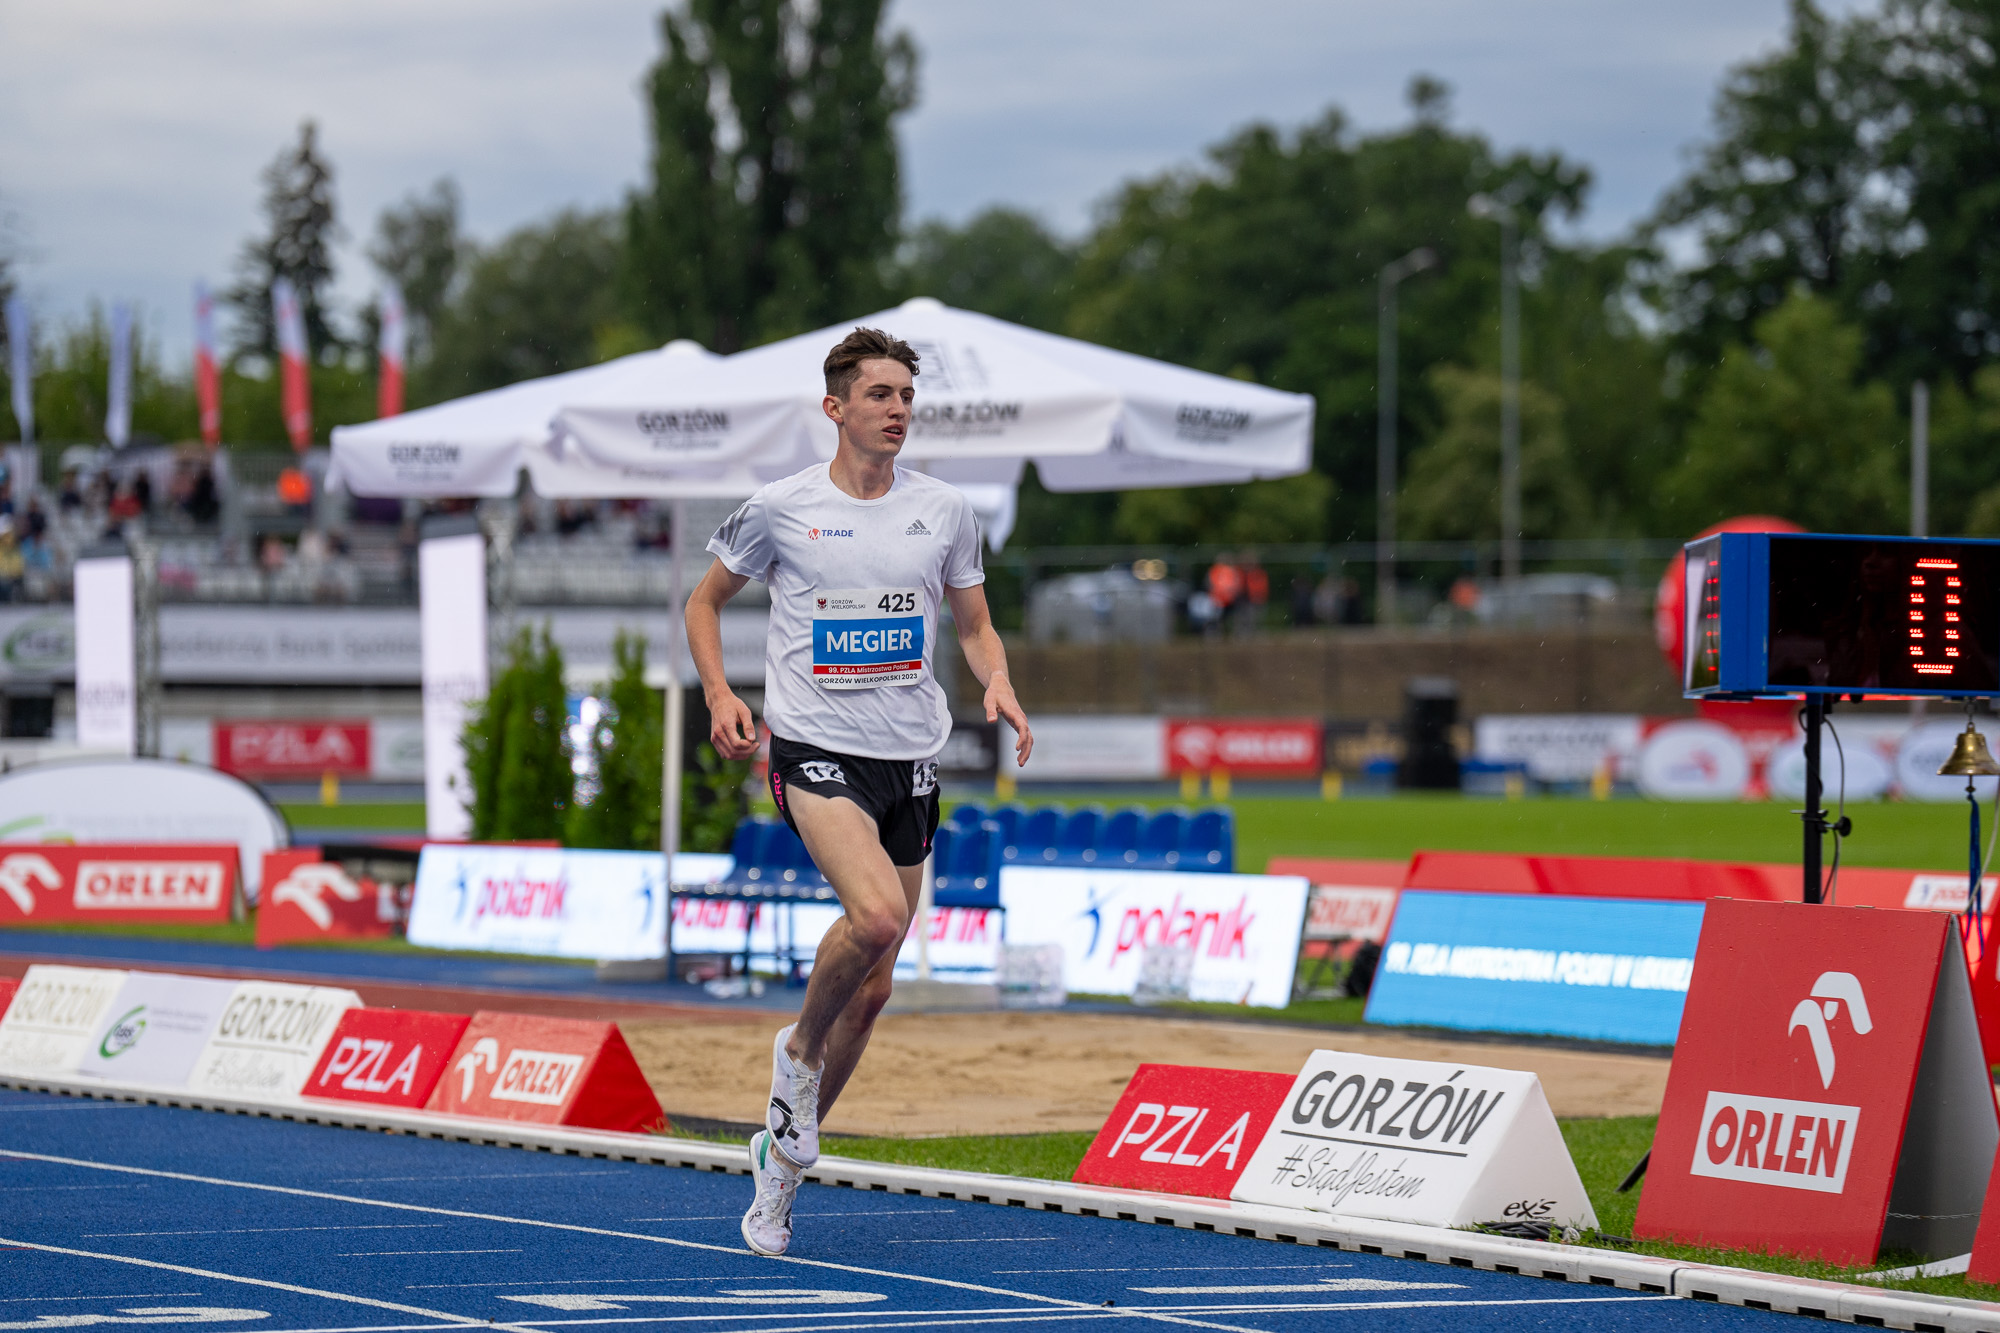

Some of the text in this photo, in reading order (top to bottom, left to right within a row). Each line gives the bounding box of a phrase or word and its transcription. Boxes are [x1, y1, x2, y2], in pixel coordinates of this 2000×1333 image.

[637, 407, 730, 432] GORZÓW
[912, 401, 1021, 423] ORZÓW
[821, 529, 854, 538] TRADE
[877, 592, 915, 613] 425
[826, 628, 913, 653] MEGIER
[818, 672, 918, 684] GORZÓW WIELKOPOLSKI 2023
[857, 665, 892, 673] Mistrzostwa
[87, 873, 210, 898] ORLEN
[1109, 893, 1256, 969] polanik
[319, 1036, 423, 1096] PZLA
[502, 1056, 574, 1097] ORLEN
[1291, 1070, 1505, 1146] GORZÓW
[1107, 1102, 1250, 1171] PZLA
[1706, 1105, 1848, 1179] ORLEN
[1270, 1143, 1426, 1208] #StądJestem
